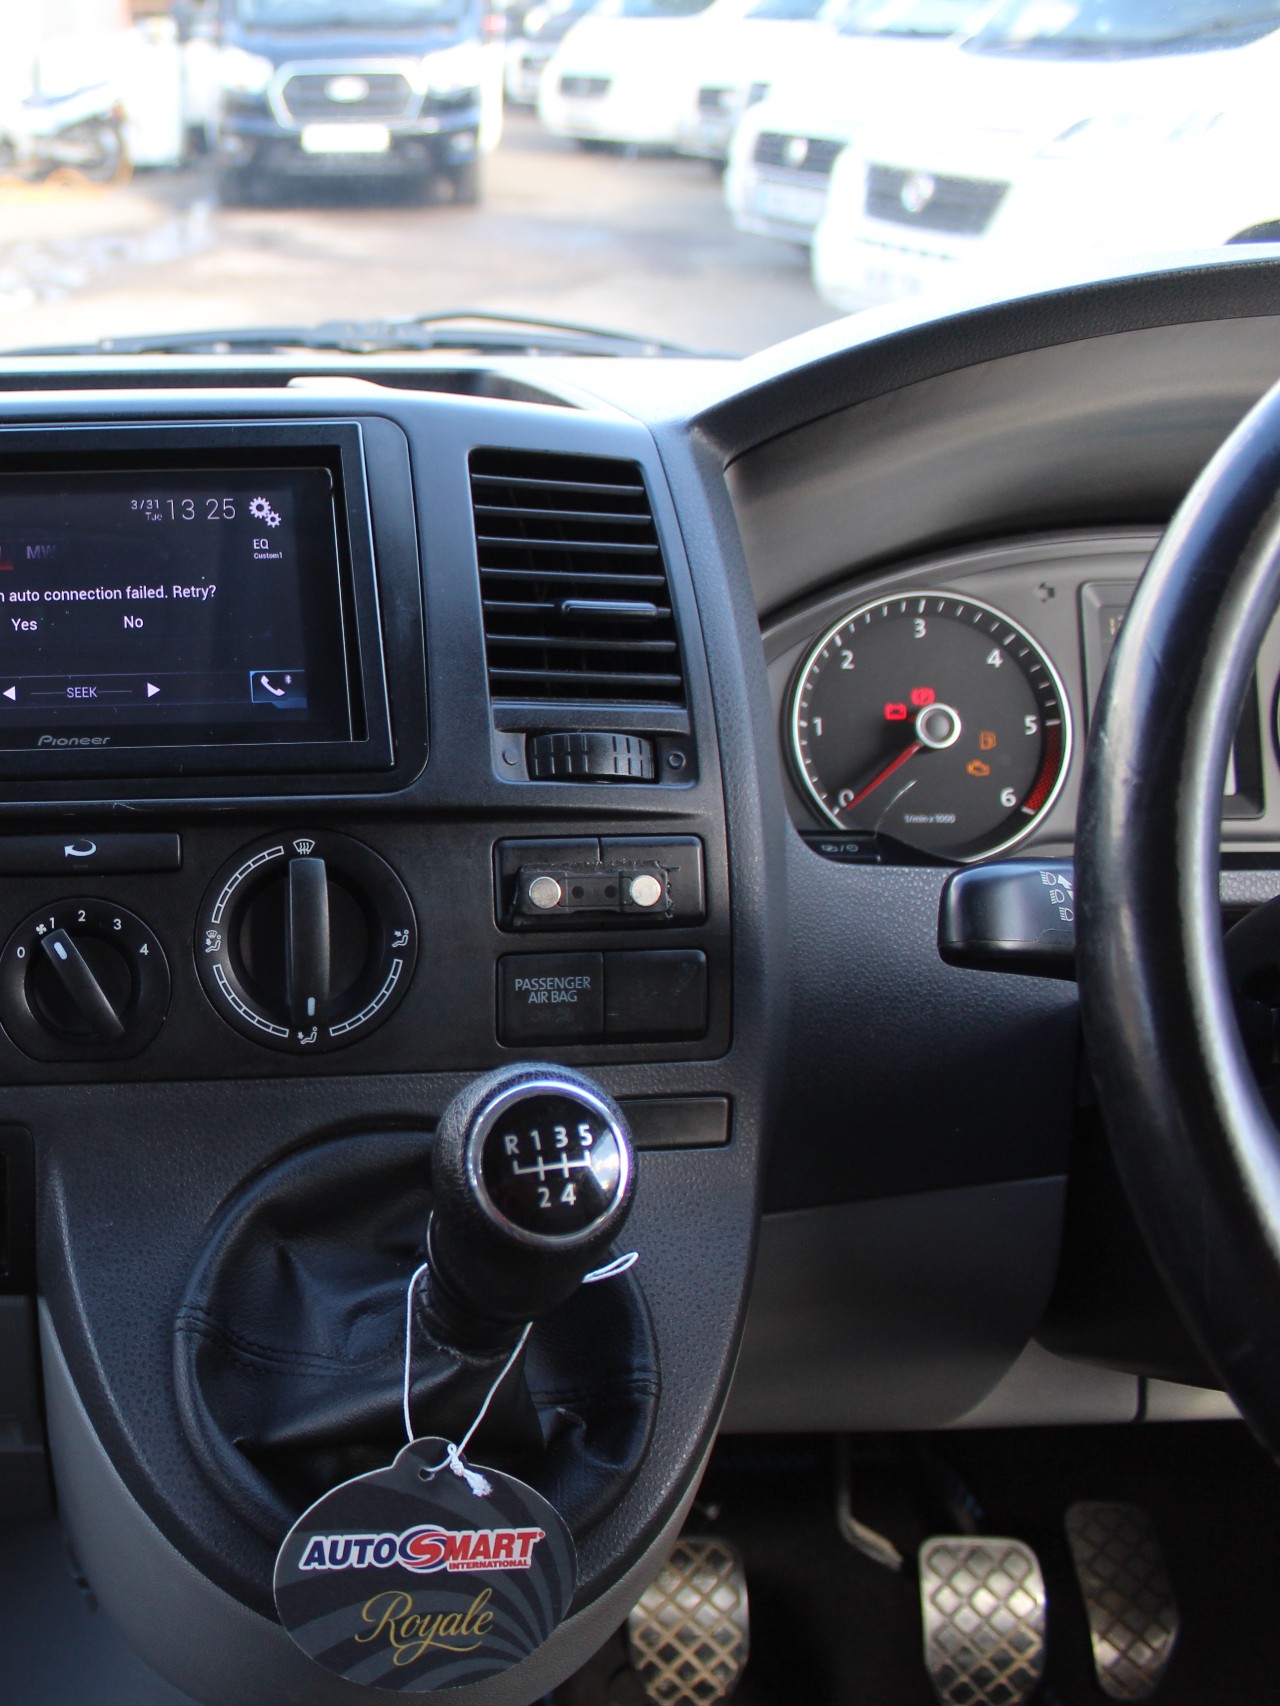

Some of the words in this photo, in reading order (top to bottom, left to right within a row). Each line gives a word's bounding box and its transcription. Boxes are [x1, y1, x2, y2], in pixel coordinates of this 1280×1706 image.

[131, 499, 159, 510] 3/31
[253, 538, 269, 550] EQ
[253, 552, 283, 560] Custom1
[9, 590, 40, 602] auto
[44, 586, 122, 601] connection
[126, 584, 168, 600] failed.
[173, 584, 217, 601] Retry?
[11, 618, 38, 631] Yes
[124, 615, 144, 628] No
[913, 618, 927, 639] 3
[840, 649, 855, 670] 2
[986, 648, 1003, 668] 4
[66, 686, 98, 699] SEEK
[812, 717, 823, 737] 1
[1024, 714, 1038, 735] 5
[37, 734, 111, 746] Pioneer
[999, 787, 1017, 808] 6
[78, 910, 87, 922] 2
[49, 917, 56, 929] 1
[113, 918, 123, 931] 3
[16, 946, 26, 959] 0
[139, 943, 150, 956] 4
[515, 976, 591, 991] PASSENGER
[528, 991, 549, 1004] AIR
[551, 990, 578, 1003] BAG
[504, 1134, 520, 1156] R
[529, 1129, 542, 1151] 1
[553, 1125, 569, 1148] 3
[577, 1123, 593, 1146] 5
[537, 1186, 552, 1208] 2
[560, 1182, 577, 1206] 4
[449, 1558, 531, 1571] INTERNATIONAL
[354, 1587, 495, 1667] Royale
